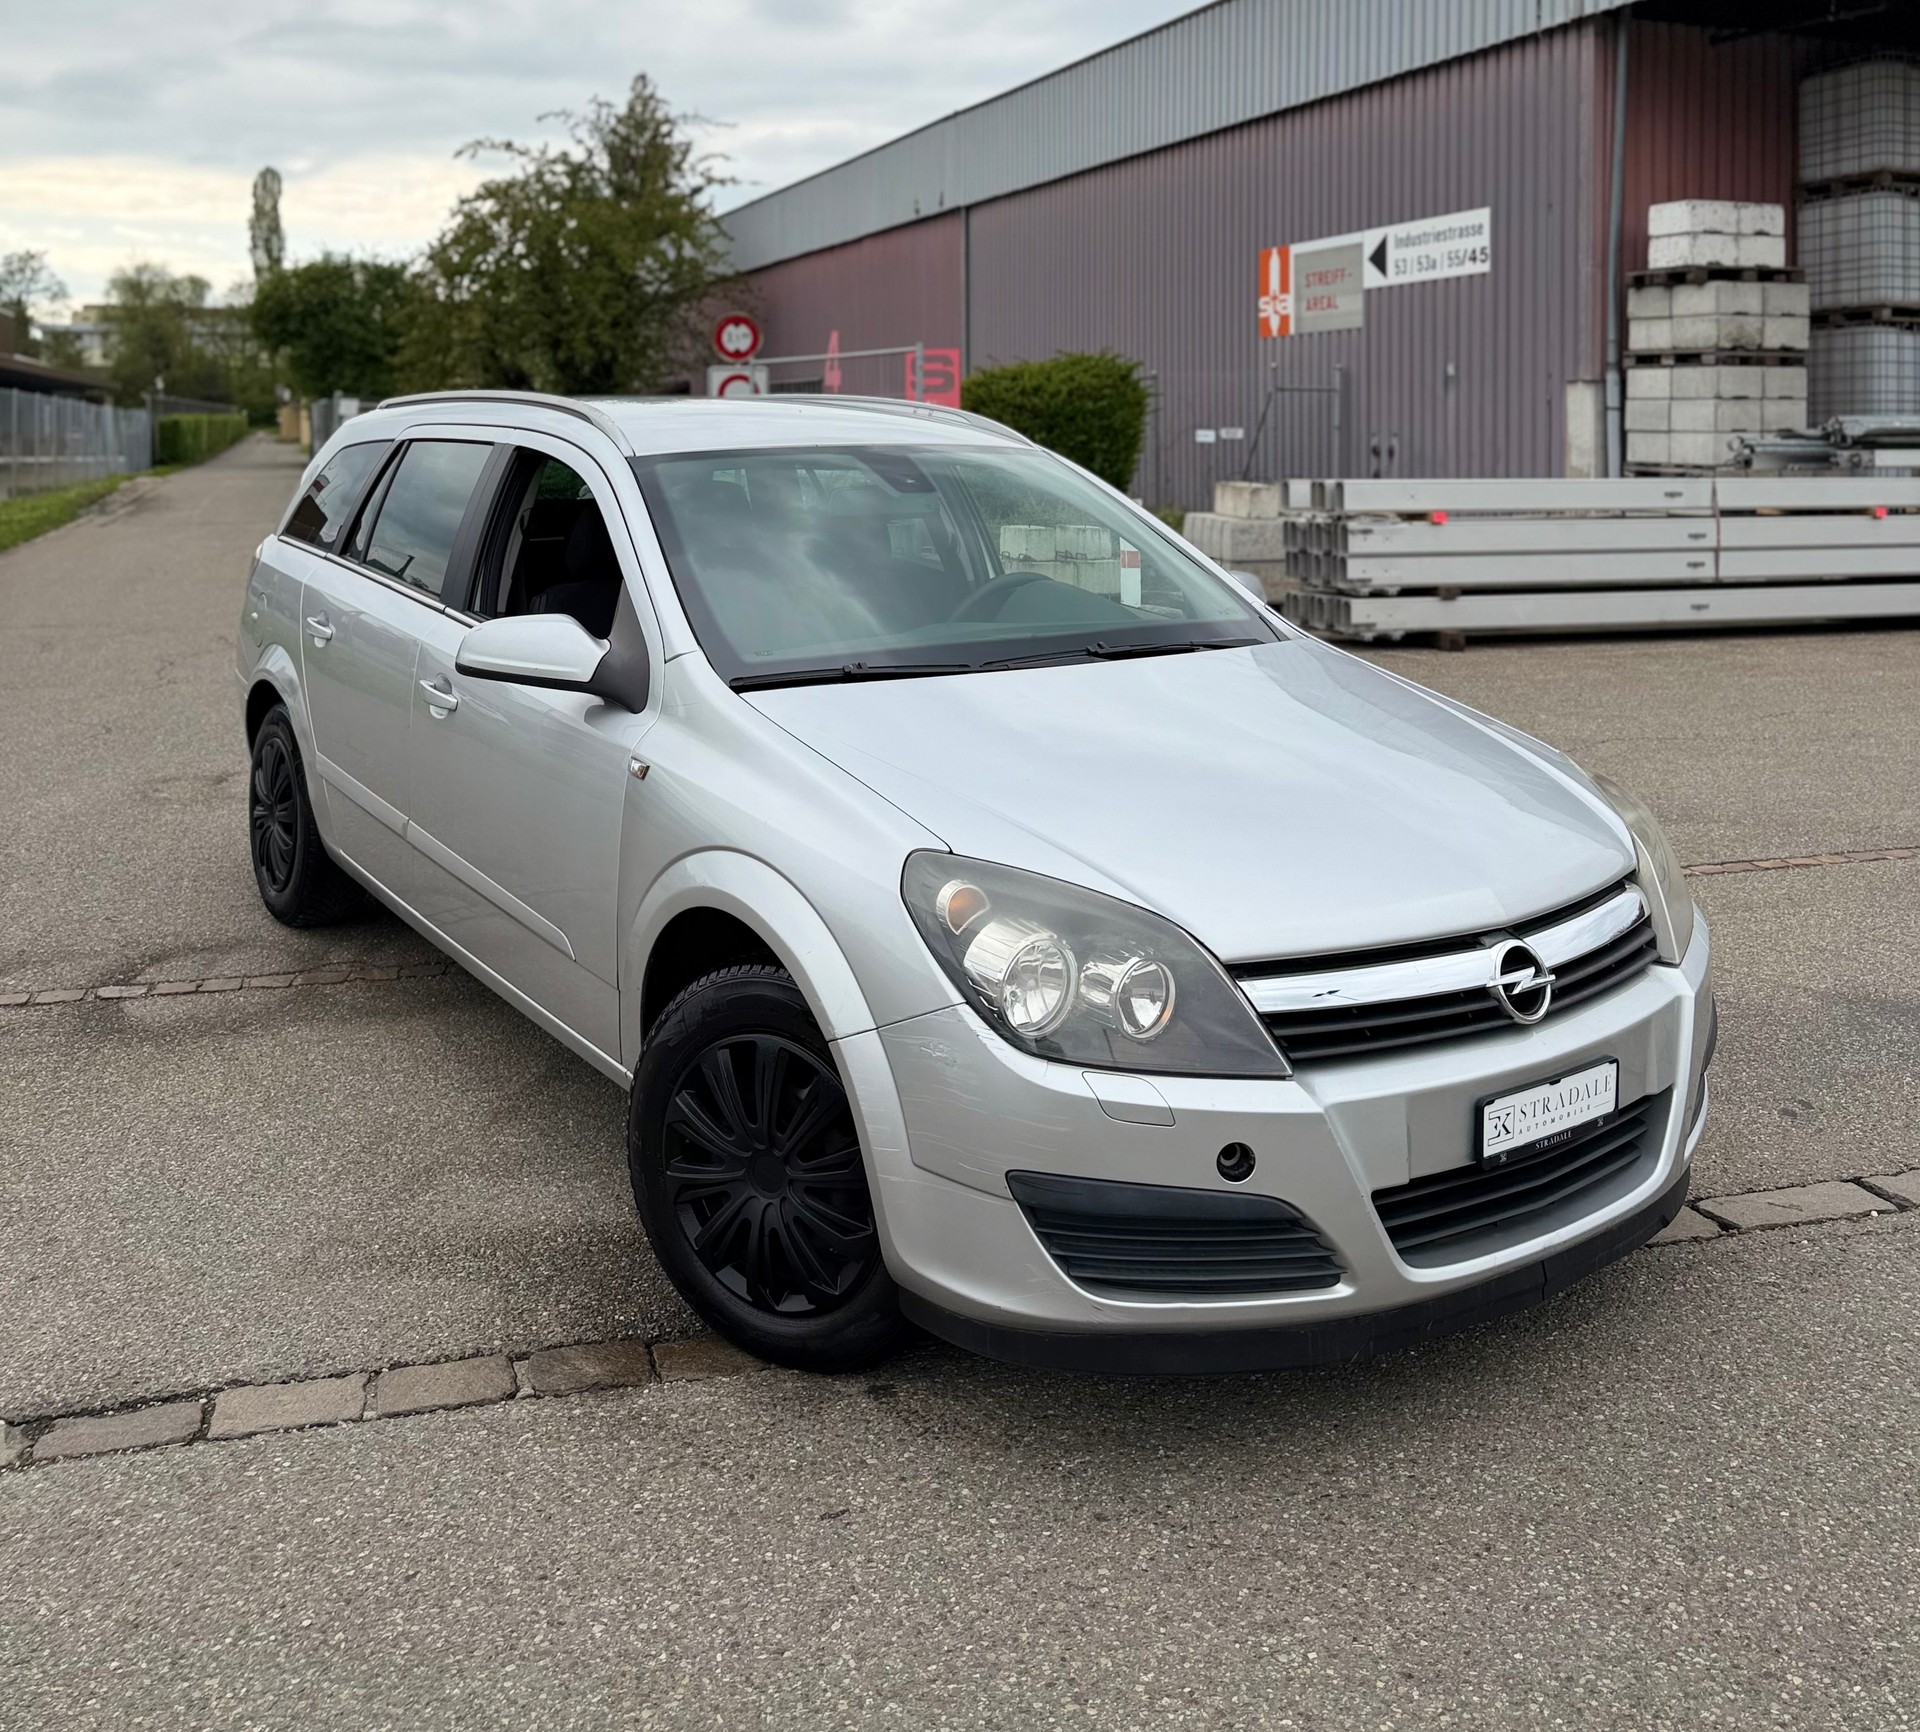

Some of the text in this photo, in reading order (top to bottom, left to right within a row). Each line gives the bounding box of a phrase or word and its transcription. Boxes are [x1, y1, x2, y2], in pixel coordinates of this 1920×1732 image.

[1394, 222, 1484, 249] Industriestrasse
[1394, 258, 1407, 276] 53
[1305, 294, 1339, 312] AREAL
[1519, 1073, 1612, 1122] STRADALE
[1518, 1104, 1591, 1135] AUTOMOBILE
[1535, 1130, 1573, 1150] STRADALE
